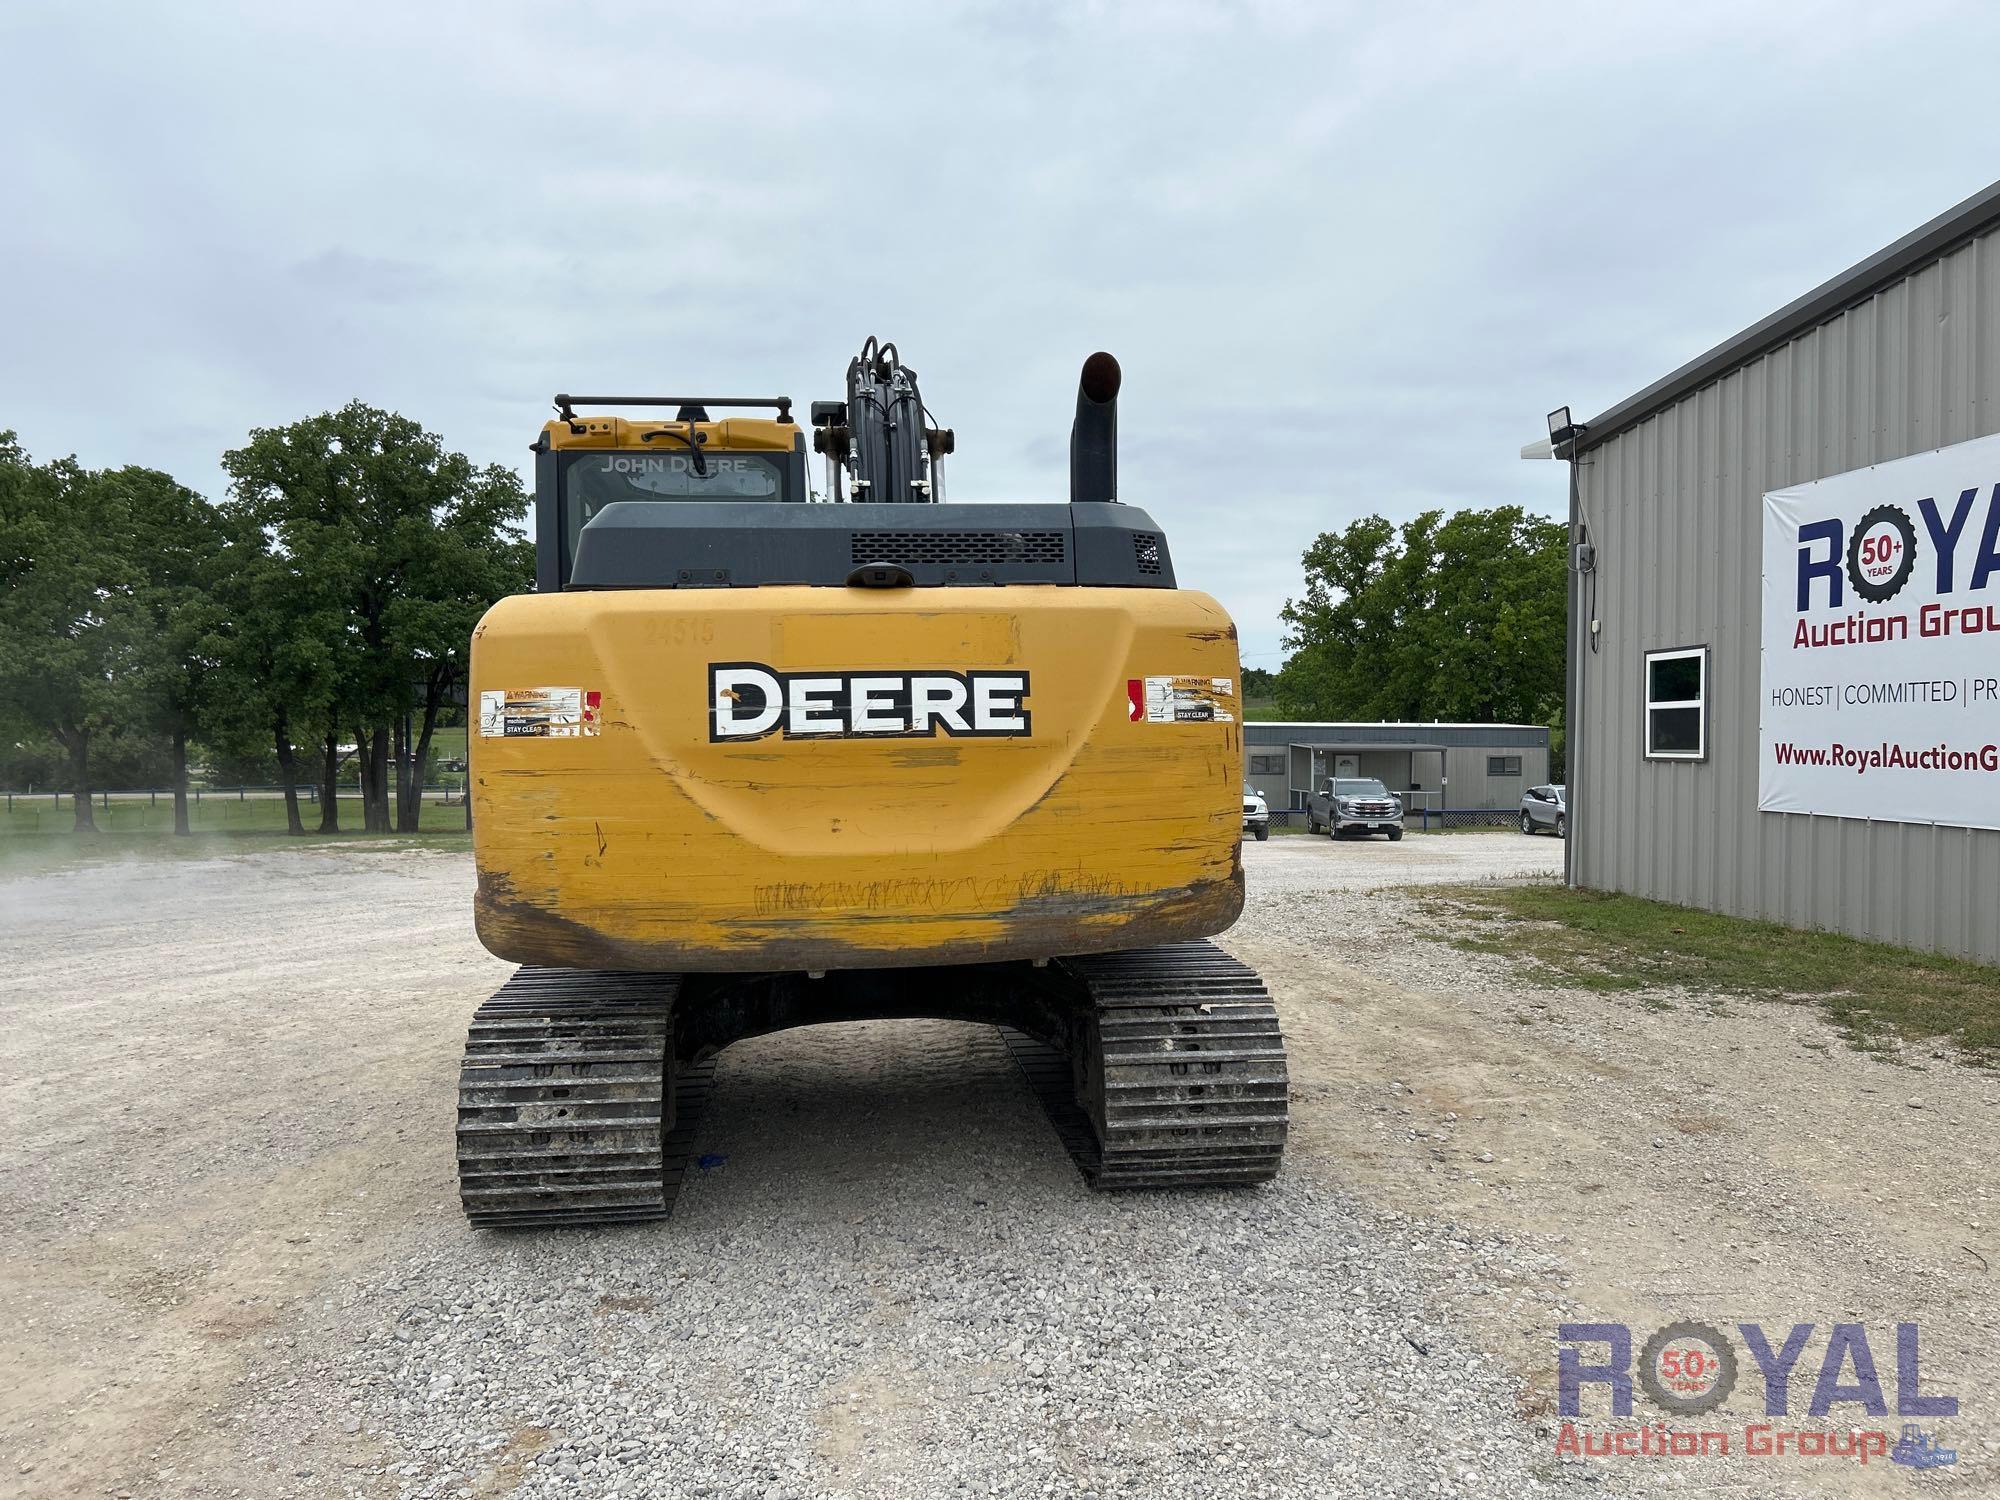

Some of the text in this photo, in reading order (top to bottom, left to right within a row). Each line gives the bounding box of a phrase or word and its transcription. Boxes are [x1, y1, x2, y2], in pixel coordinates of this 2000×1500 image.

[601, 455, 664, 472] JOHN
[1861, 534, 1902, 565] 50+
[1867, 565, 1893, 577] YEARS
[1793, 611, 1908, 649] Auction
[715, 668, 1025, 735] DEERE
[1772, 686, 1834, 706] HONEST
[1844, 680, 1957, 705] COMMITTED
